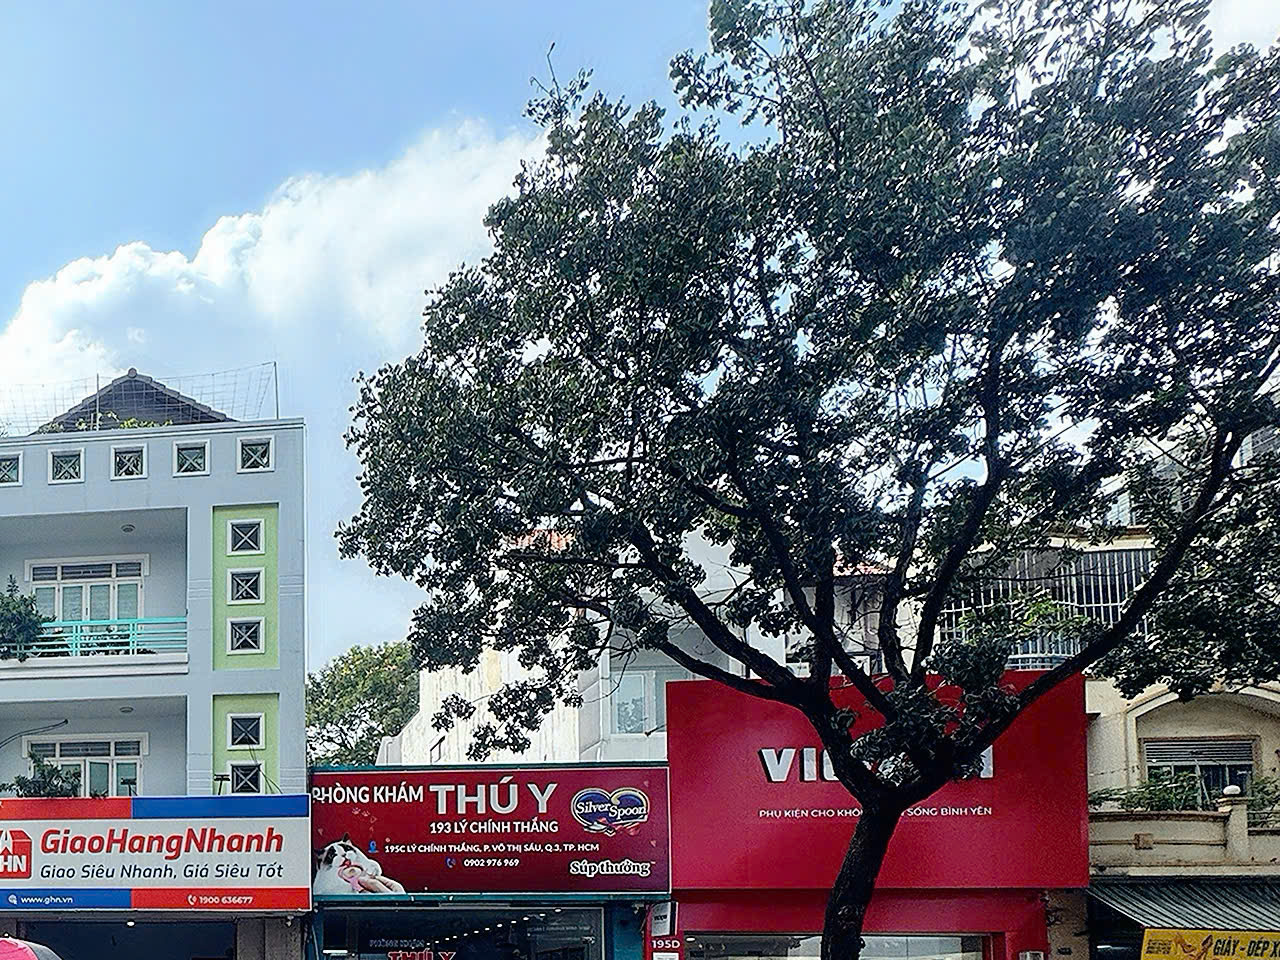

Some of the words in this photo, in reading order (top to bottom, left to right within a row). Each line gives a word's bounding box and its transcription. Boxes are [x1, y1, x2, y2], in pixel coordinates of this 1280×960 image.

[312, 782, 370, 804] PHÒNG
[373, 781, 424, 803] KHÁM
[429, 776, 518, 815] THÚ
[526, 784, 558, 814] Y
[576, 801, 611, 814] Silver
[608, 806, 647, 820] Spoon
[811, 809, 834, 817] CHO
[837, 808, 864, 817] KHÔ
[970, 806, 992, 816] YÊN
[429, 821, 452, 835] 193
[455, 819, 470, 834] LÝ
[470, 819, 511, 834] CHÍNH
[40, 826, 284, 860] GiaoHangNhanh
[385, 845, 406, 853] 195C
[407, 843, 418, 853] LÝ
[418, 843, 447, 853] CHÍNH
[492, 842, 506, 852] VÕ
[523, 842, 543, 852] SÁU,
[577, 843, 600, 851] HCM
[464, 859, 485, 867] 0902
[486, 858, 502, 867] 976
[503, 858, 520, 867] 969
[570, 859, 598, 877] Súp
[40, 864, 76, 879] Giao
[81, 863, 115, 878] Siêu
[121, 864, 177, 880] Nhanh,
[183, 863, 209, 878] Giá
[215, 863, 250, 878] Siêu
[256, 861, 284, 878] Tốt
[21, 895, 73, 904] www.ghn.vn
[199, 896, 219, 904] 1900
[221, 896, 253, 904] 636677
[652, 940, 680, 949] 195D
